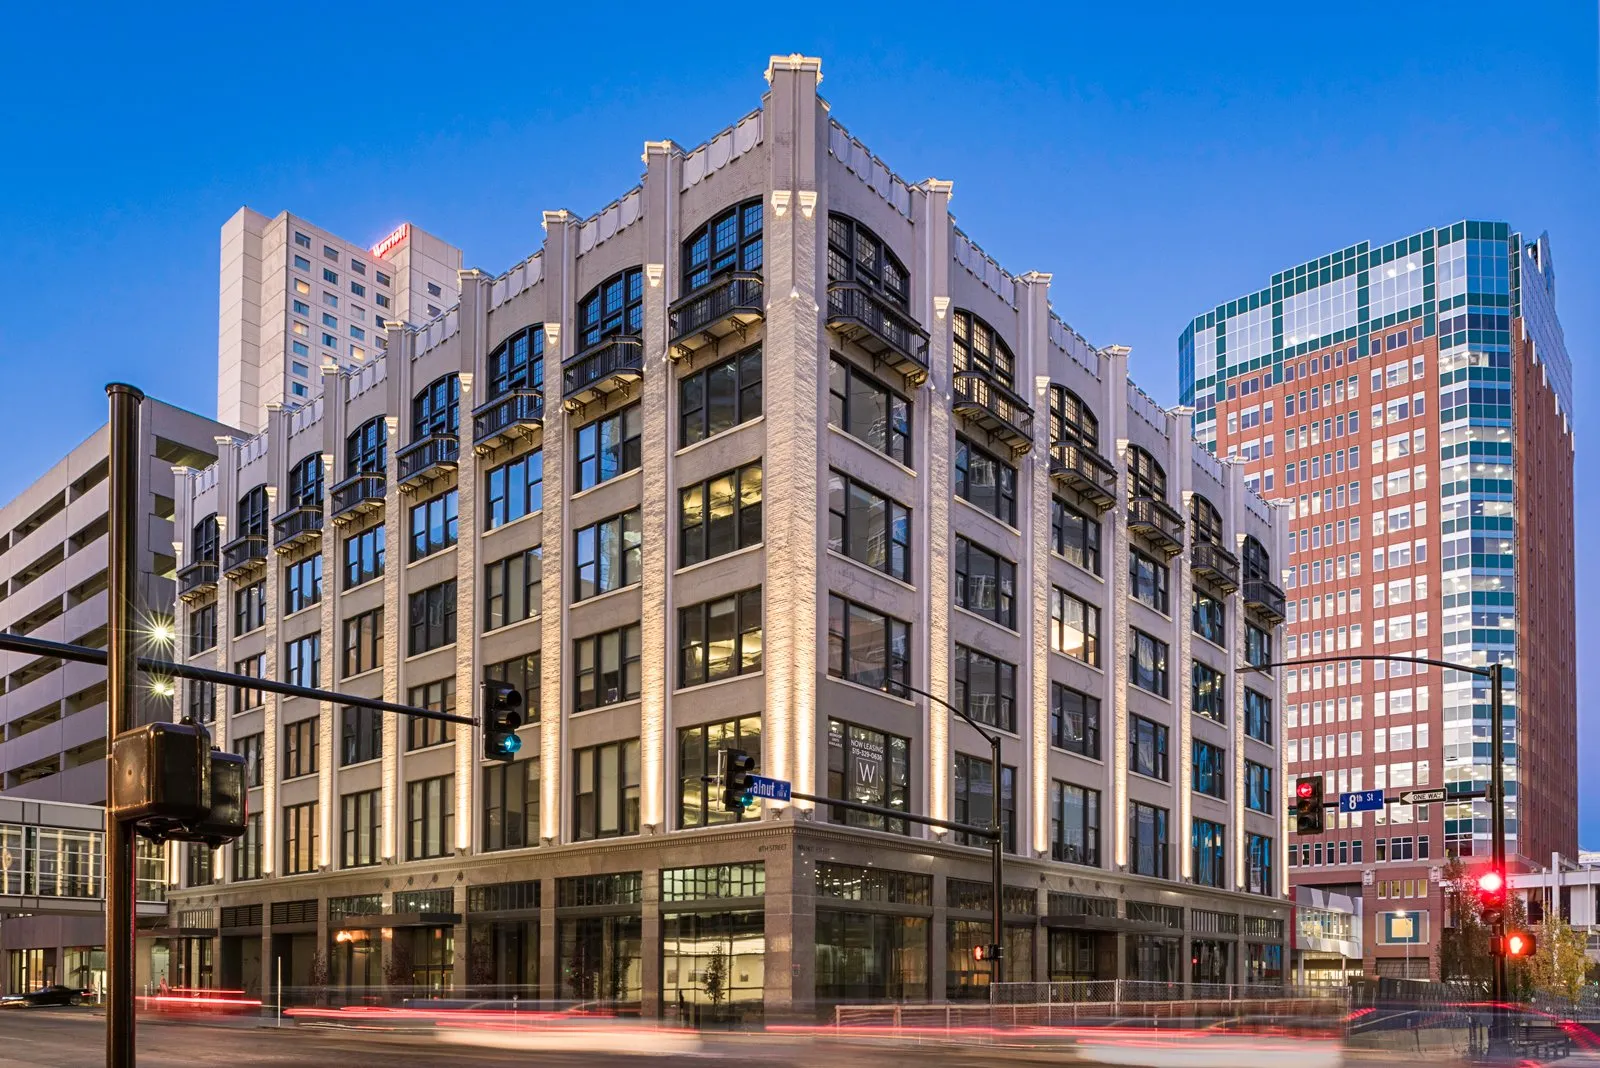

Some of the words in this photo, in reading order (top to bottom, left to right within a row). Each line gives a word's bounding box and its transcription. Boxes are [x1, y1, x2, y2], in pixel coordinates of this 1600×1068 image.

[850, 739, 863, 748] NOW
[863, 743, 884, 754] LEASING
[852, 747, 883, 761] 515-329-0636
[859, 762, 875, 784] W
[747, 779, 775, 797] alnut
[1348, 794, 1363, 810] 8th
[1366, 793, 1374, 802] St
[1413, 793, 1426, 801] ONE
